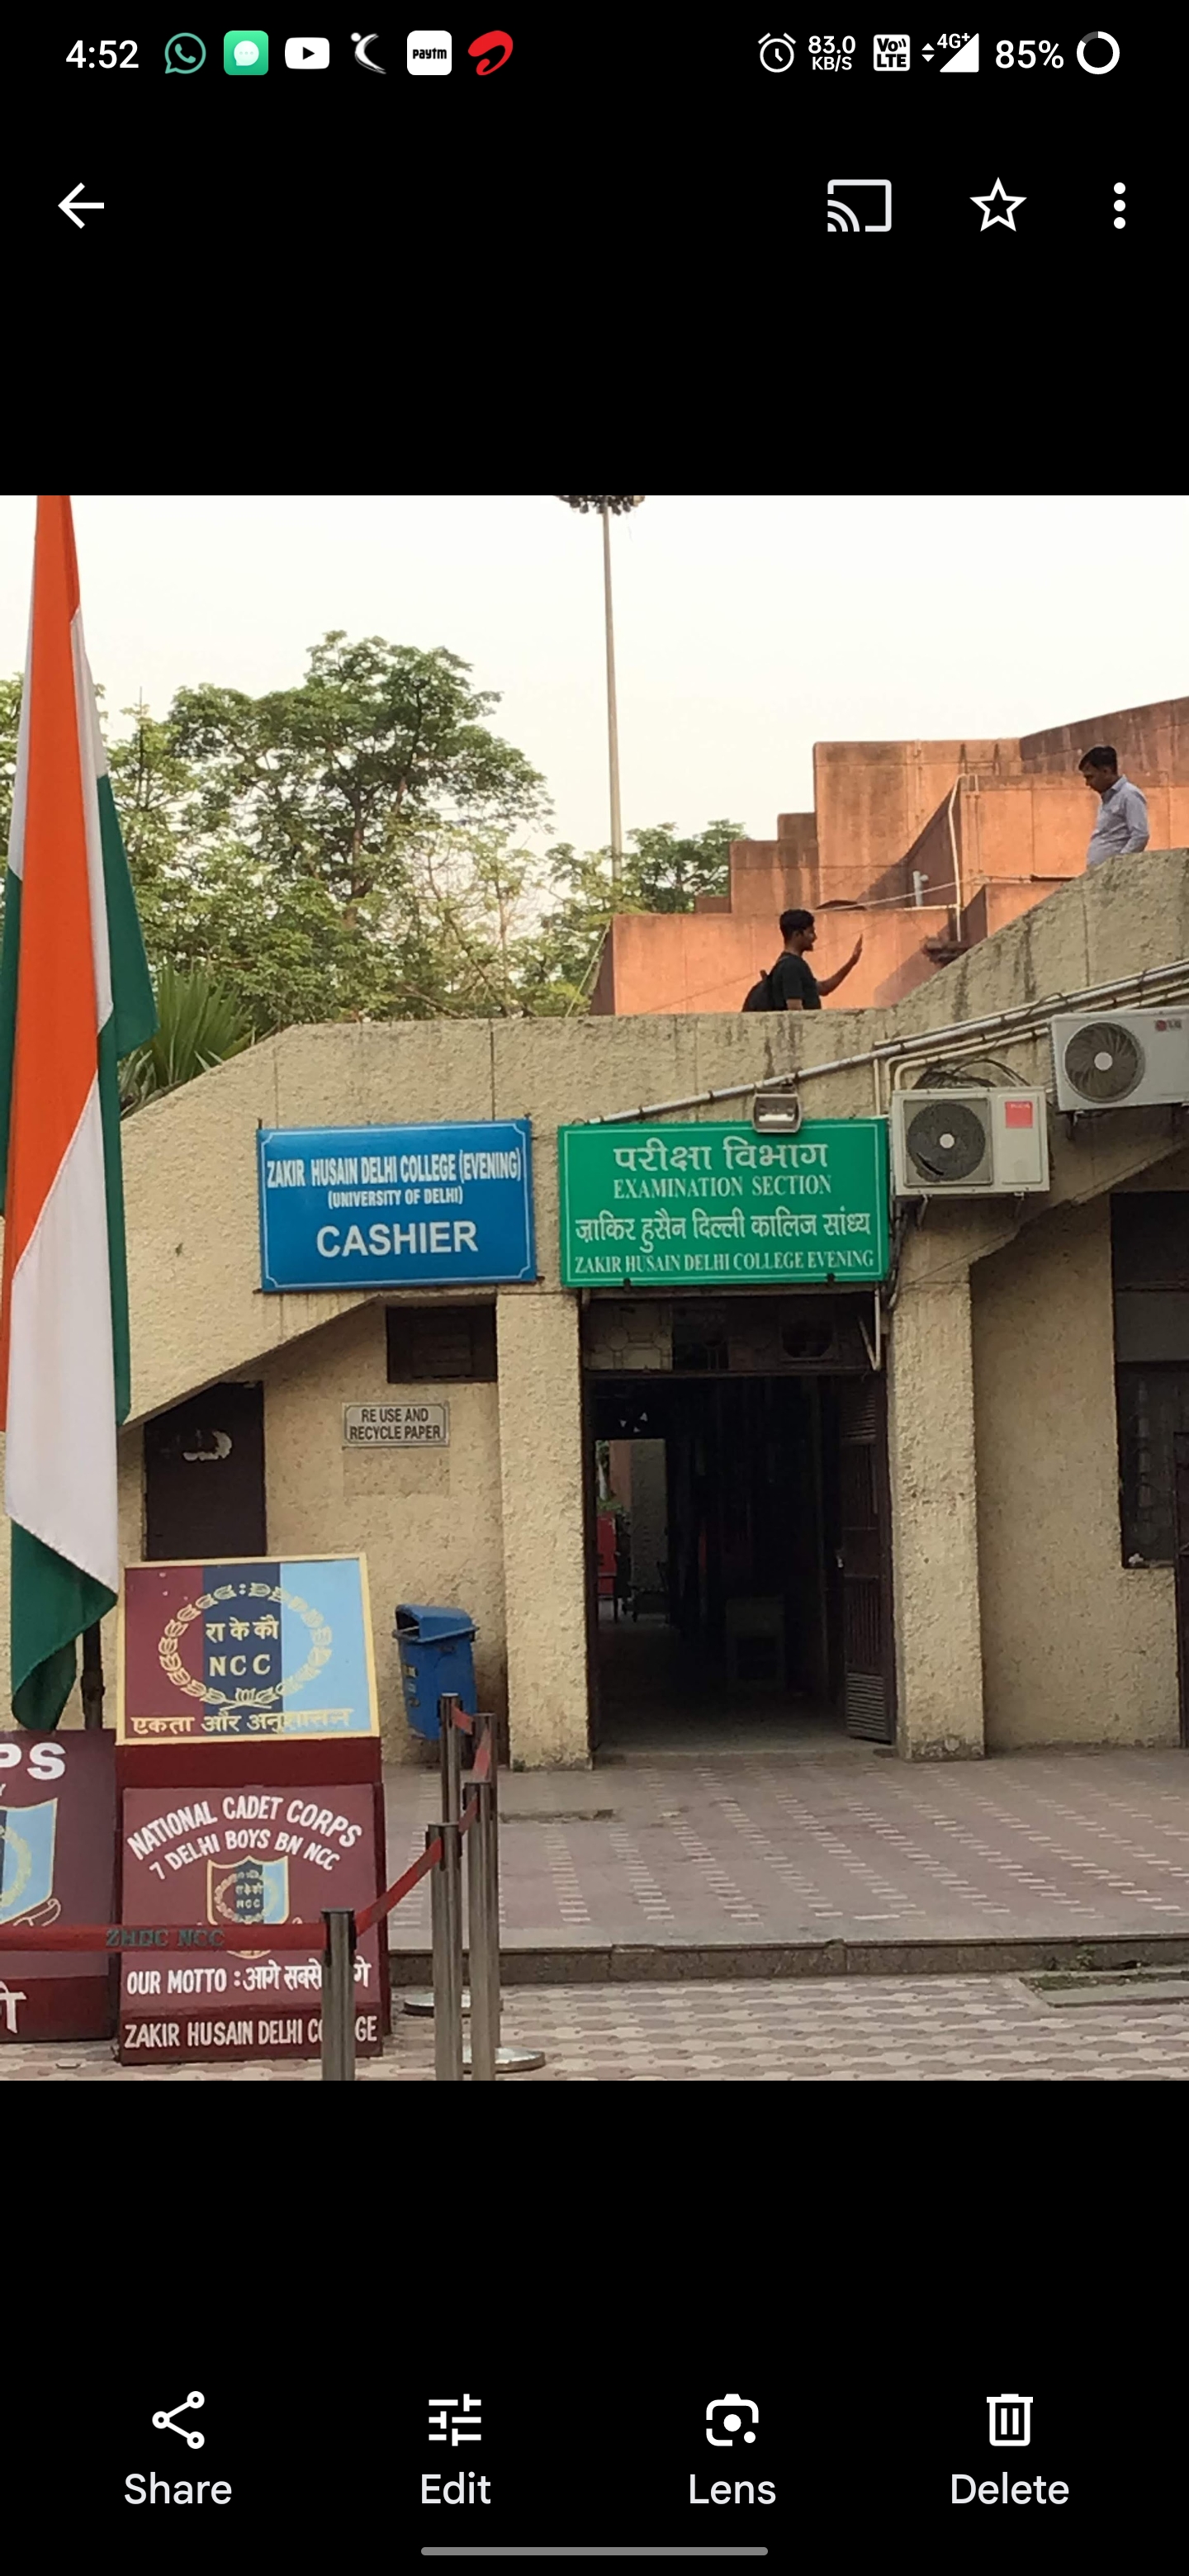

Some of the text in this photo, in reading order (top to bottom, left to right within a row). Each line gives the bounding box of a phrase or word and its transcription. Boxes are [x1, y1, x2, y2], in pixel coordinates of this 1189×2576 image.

[267, 1148, 521, 1188] ZAKIR HUSAIN DELHI COLLEGE (EVENING)
[613, 1135, 828, 1172] परीक्षा विभाग
[328, 1186, 463, 1210] (UNIVERSITY OF DELHI)
[613, 1174, 831, 1199] EXAMINATION SECTION
[317, 1220, 478, 1257] CASHIER
[640, 1208, 687, 1253] हुसैन
[692, 1207, 746, 1239] दिल्ली
[750, 1205, 817, 1238] कालिज
[575, 1249, 874, 1274] ZAKIR HUSAIN DELHI COLLEGE EVENING
[361, 1408, 429, 1423] RE USE AND
[349, 1425, 441, 1440] RECYCLE PAPER
[130, 1717, 196, 1735] एकता
[201, 1710, 241, 1732] और
[126, 1795, 362, 1861] NATIONAL CADET CORPS
[149, 1828, 340, 1880] 7 DELHI BOYS BN NCC
[178, 1928, 225, 1947] NCC
[126, 1971, 161, 1995] OUR
[283, 1958, 322, 1991] सबसे
[124, 2023, 180, 2048] ZAKIR
[187, 2020, 253, 2048] HUSAIN
[258, 2019, 303, 2045] DELHI
